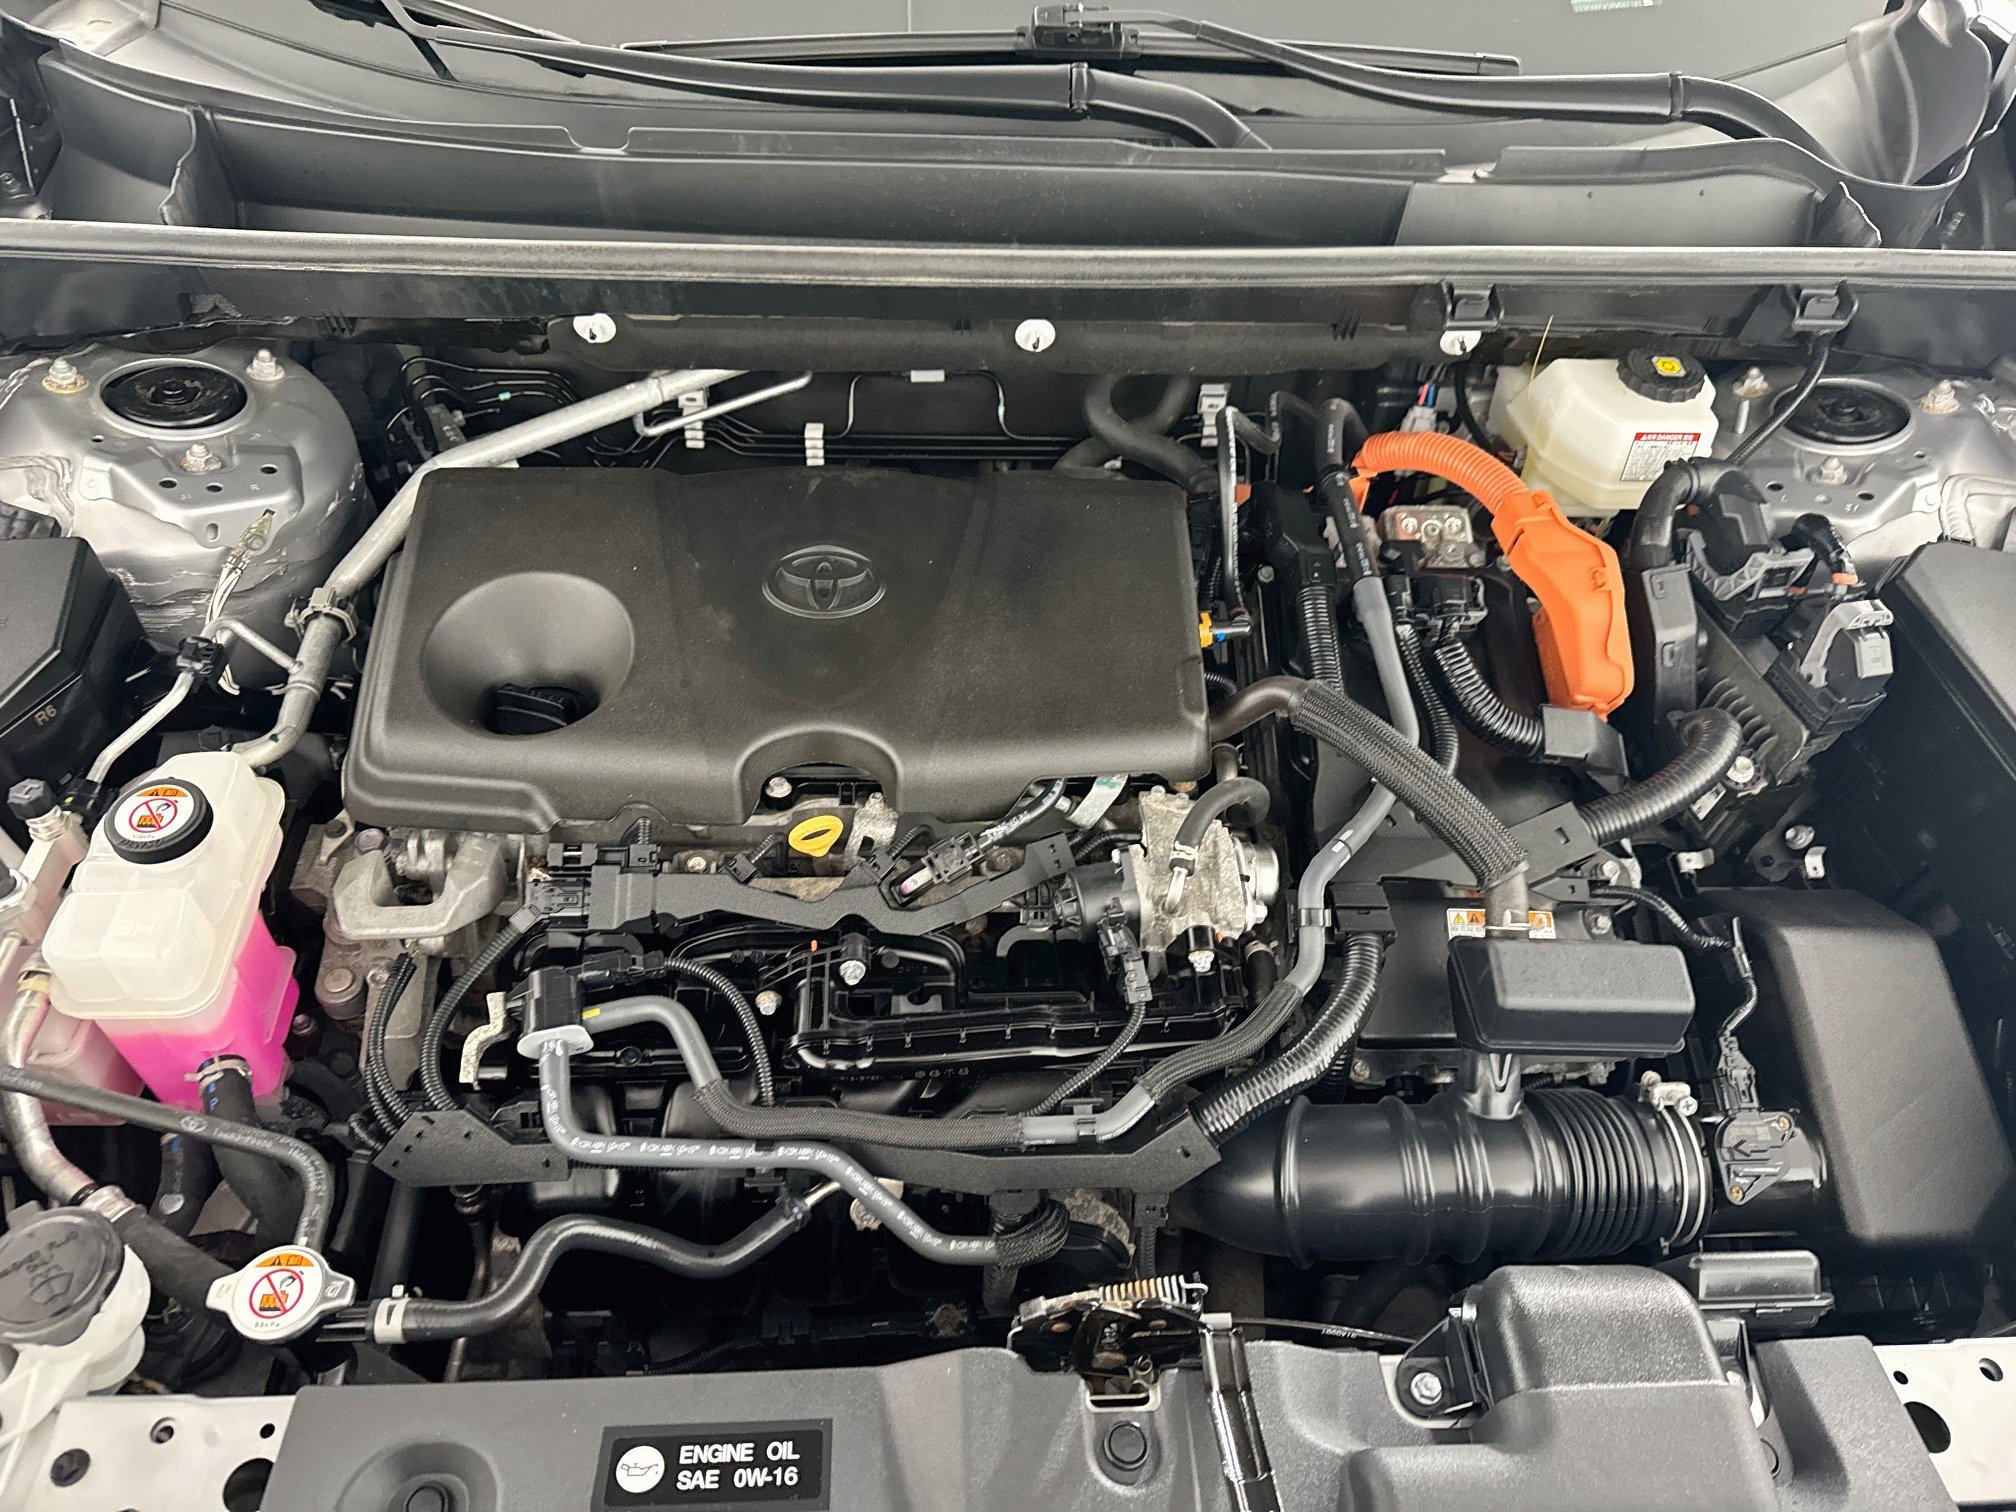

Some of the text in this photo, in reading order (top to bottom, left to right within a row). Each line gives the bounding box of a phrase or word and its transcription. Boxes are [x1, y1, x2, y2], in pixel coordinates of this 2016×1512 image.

[34, 704, 57, 726] R6
[679, 1440, 800, 1464] ENGINE OIL
[676, 1466, 798, 1490] SAE 0W-16
